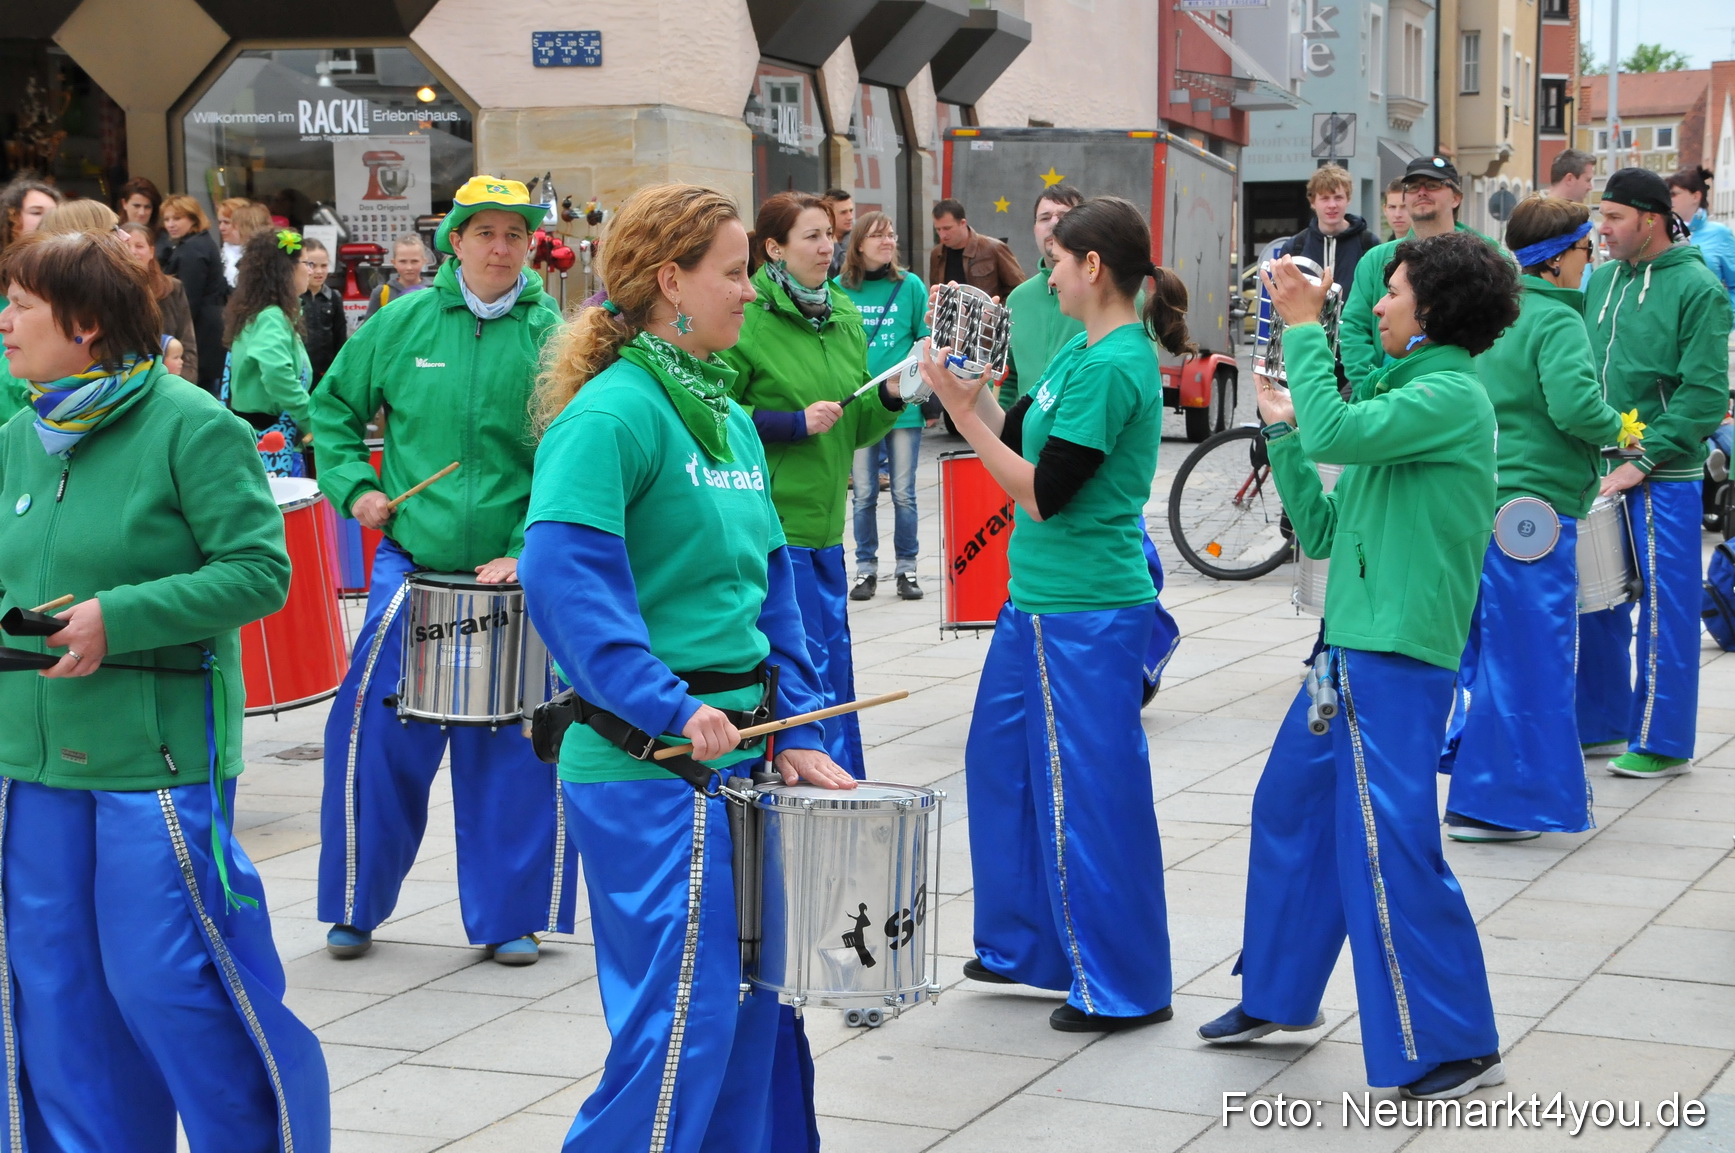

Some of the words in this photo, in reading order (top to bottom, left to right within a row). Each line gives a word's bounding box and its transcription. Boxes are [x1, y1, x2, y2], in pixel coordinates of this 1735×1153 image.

[533, 38, 539, 48] S
[555, 38, 562, 47] S
[578, 38, 585, 47] S
[193, 111, 275, 124] Willkommen
[278, 111, 295, 123] im
[298, 99, 370, 134] RACKL
[373, 110, 461, 122] Erlebnishaus.
[359, 203, 374, 211] Das
[377, 203, 410, 212] Original
[954, 498, 1015, 576] sarar
